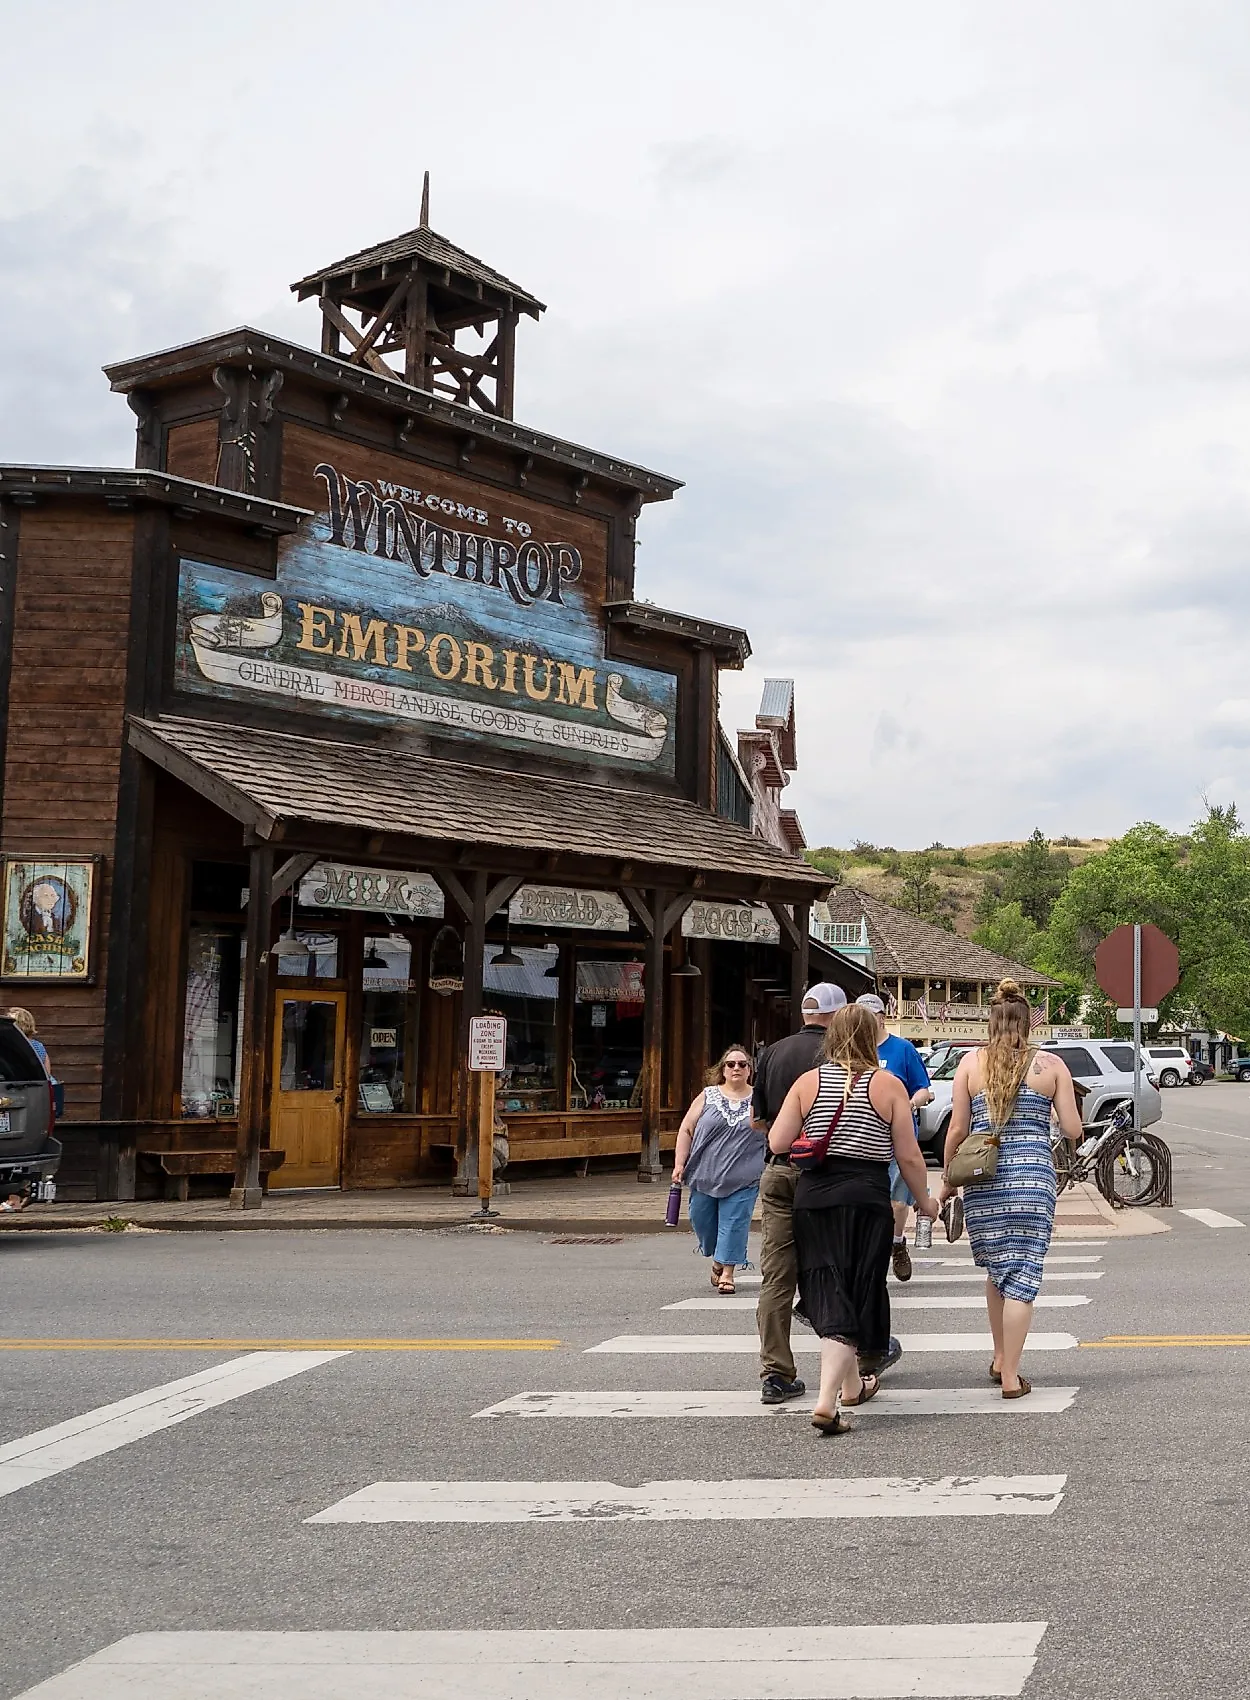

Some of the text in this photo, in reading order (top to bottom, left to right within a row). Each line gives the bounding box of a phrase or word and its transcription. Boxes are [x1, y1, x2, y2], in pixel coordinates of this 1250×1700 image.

[377, 479, 532, 538] WELCOME TO
[313, 462, 583, 608] WINTHROP
[296, 602, 599, 710] EMPORIUM
[238, 661, 629, 752] GENERAL MERCHANDISE, GOODS & SUNDRIES
[313, 867, 410, 911] MILK
[519, 888, 602, 926] BREAD
[691, 905, 753, 938] EGGS
[14, 943, 76, 955] MACHINE
[27, 933, 65, 945] CASH
[372, 1032, 396, 1044] OPEN
[475, 1022, 501, 1030] LOADING
[934, 1026, 974, 1034] MEXICAN
